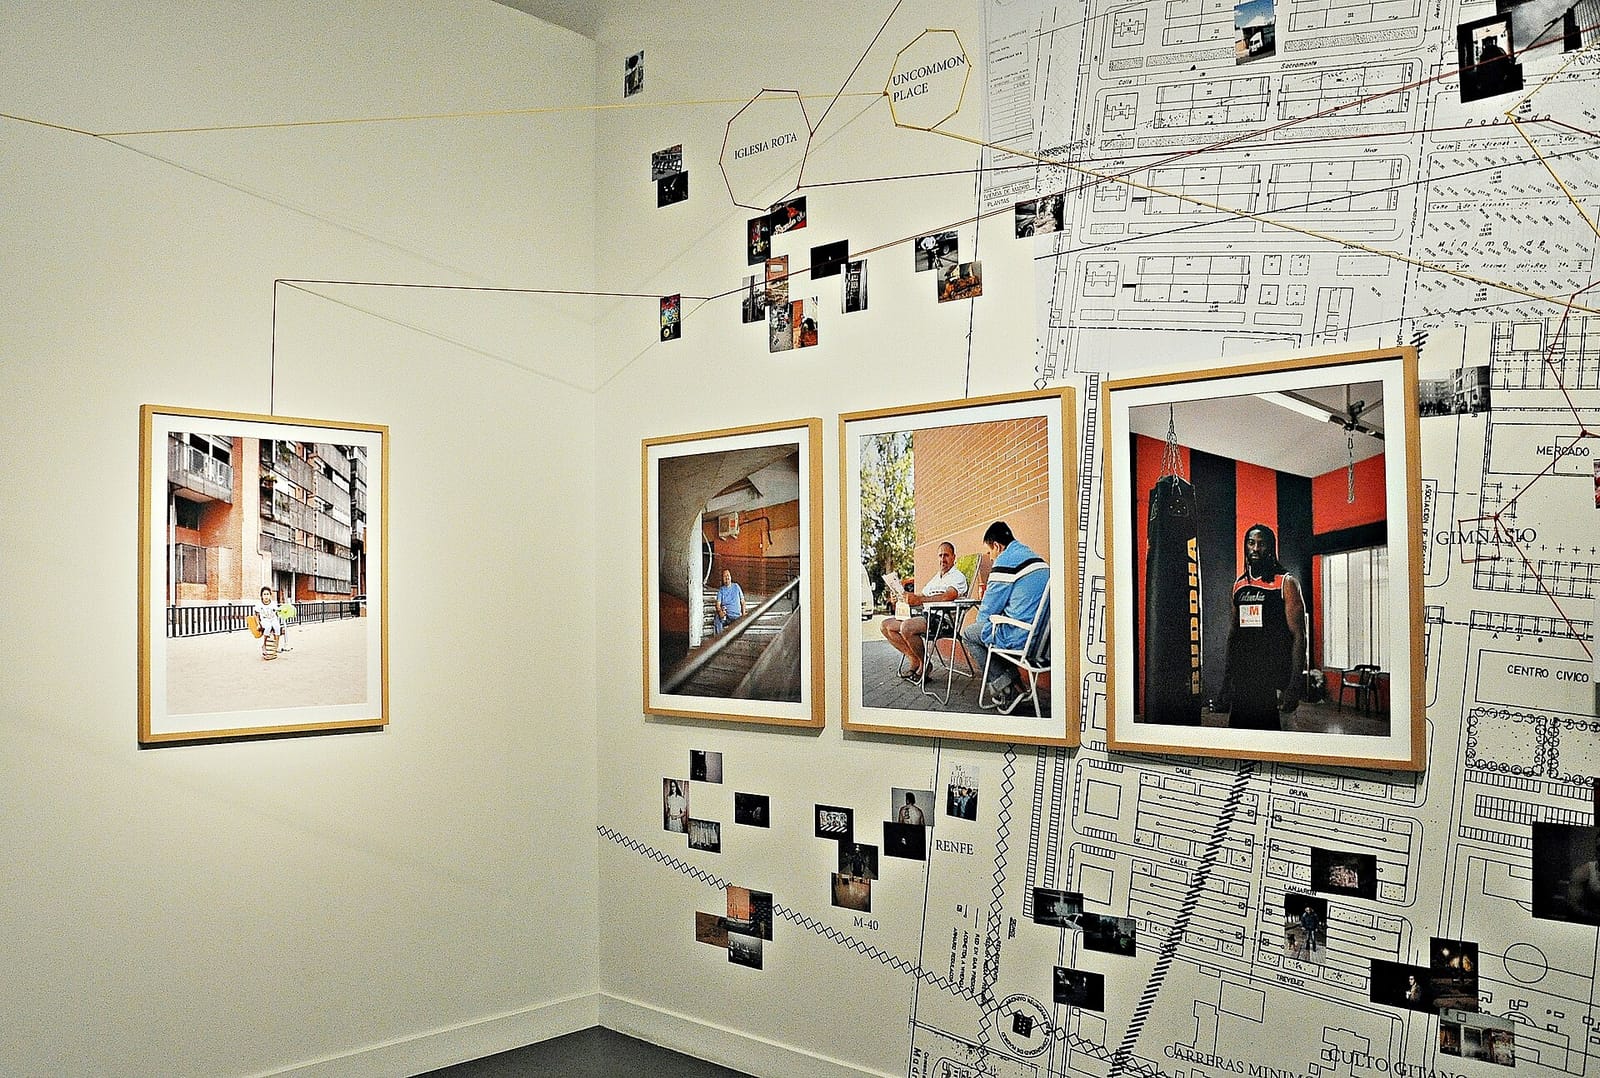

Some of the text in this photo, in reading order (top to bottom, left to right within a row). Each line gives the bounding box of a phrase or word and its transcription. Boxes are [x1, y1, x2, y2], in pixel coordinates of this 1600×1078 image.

[892, 54, 966, 86] UNCOMMON
[893, 82, 929, 102] PLACE
[734, 132, 798, 160] IGLESIA ROTA
[1536, 445, 1590, 457] MERCADO
[1436, 527, 1538, 546] GIMNASIO
[1187, 536, 1200, 695] BUDDHA
[1507, 664, 1590, 684] CENTRO CIVICO
[1175, 767, 1193, 777] CALLE
[935, 839, 974, 856] RENFE
[1169, 857, 1188, 867] CALLE
[853, 916, 879, 931] M-40
[1163, 1045, 1245, 1074] CARRERAS
[1328, 1048, 1389, 1072] CULTO
